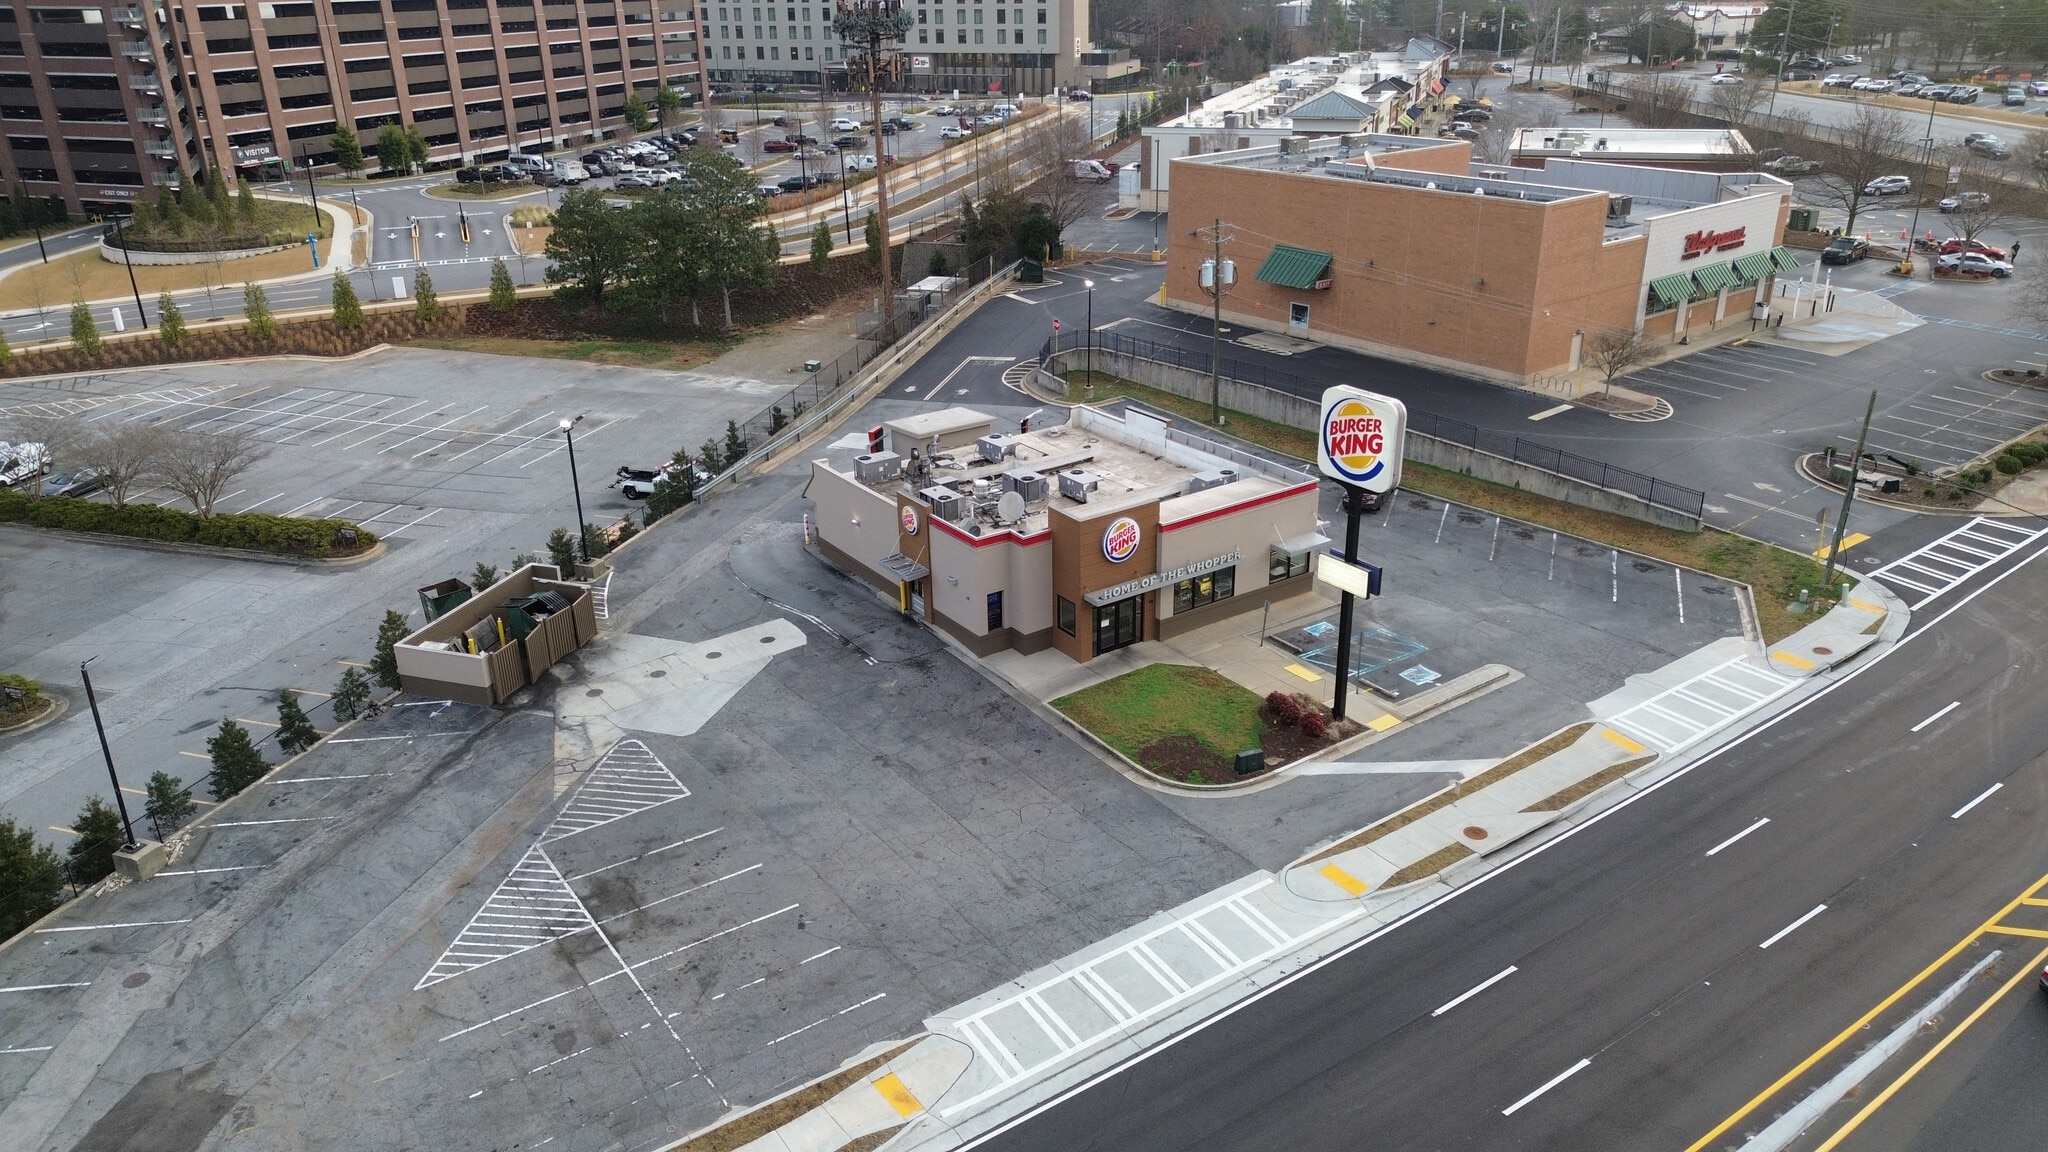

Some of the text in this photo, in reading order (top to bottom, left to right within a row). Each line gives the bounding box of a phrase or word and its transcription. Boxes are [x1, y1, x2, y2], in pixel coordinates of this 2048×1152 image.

[244, 147, 270, 157] VISITOR
[1685, 226, 1746, 254] Walgreens
[1330, 418, 1382, 436] BURGER
[1331, 434, 1384, 457] KING
[1109, 524, 1136, 546] BURGER
[1110, 532, 1137, 555] KING
[1103, 551, 1241, 600] HOME OF THE WHOPPER
